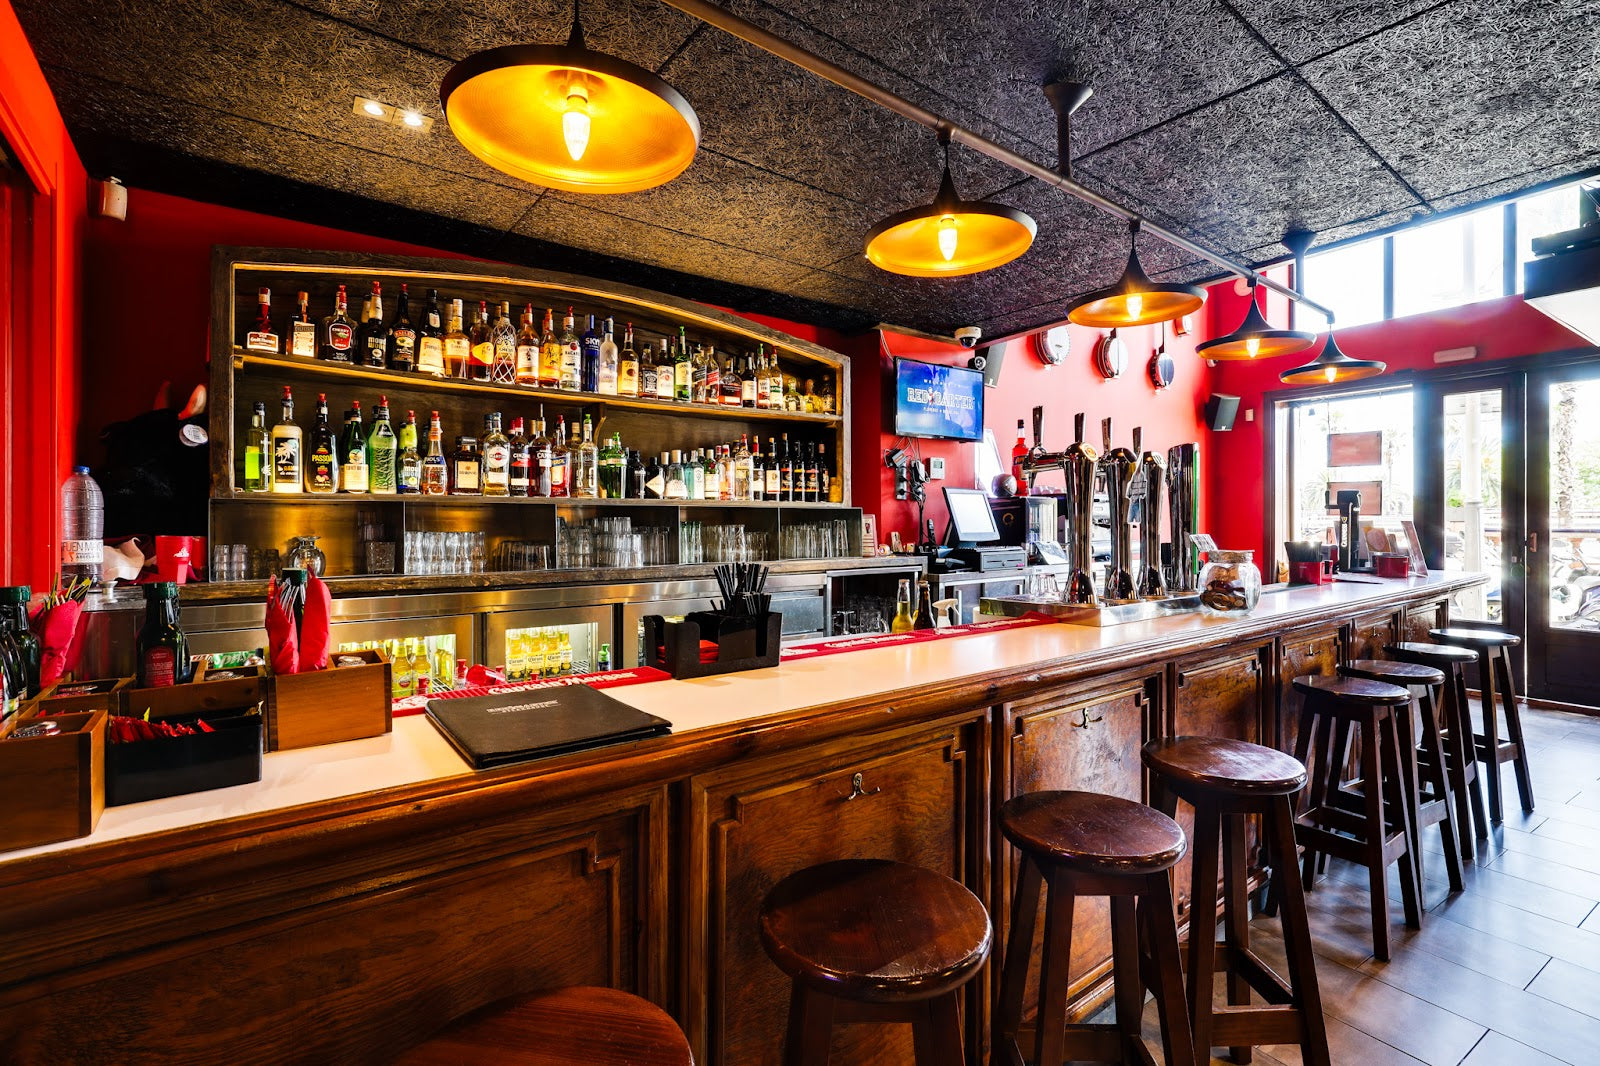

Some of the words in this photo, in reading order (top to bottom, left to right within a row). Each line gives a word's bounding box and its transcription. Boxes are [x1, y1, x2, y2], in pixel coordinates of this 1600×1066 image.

[907, 387, 928, 404] RED
[488, 681, 565, 695] Captain
[564, 671, 638, 686] Morgan
